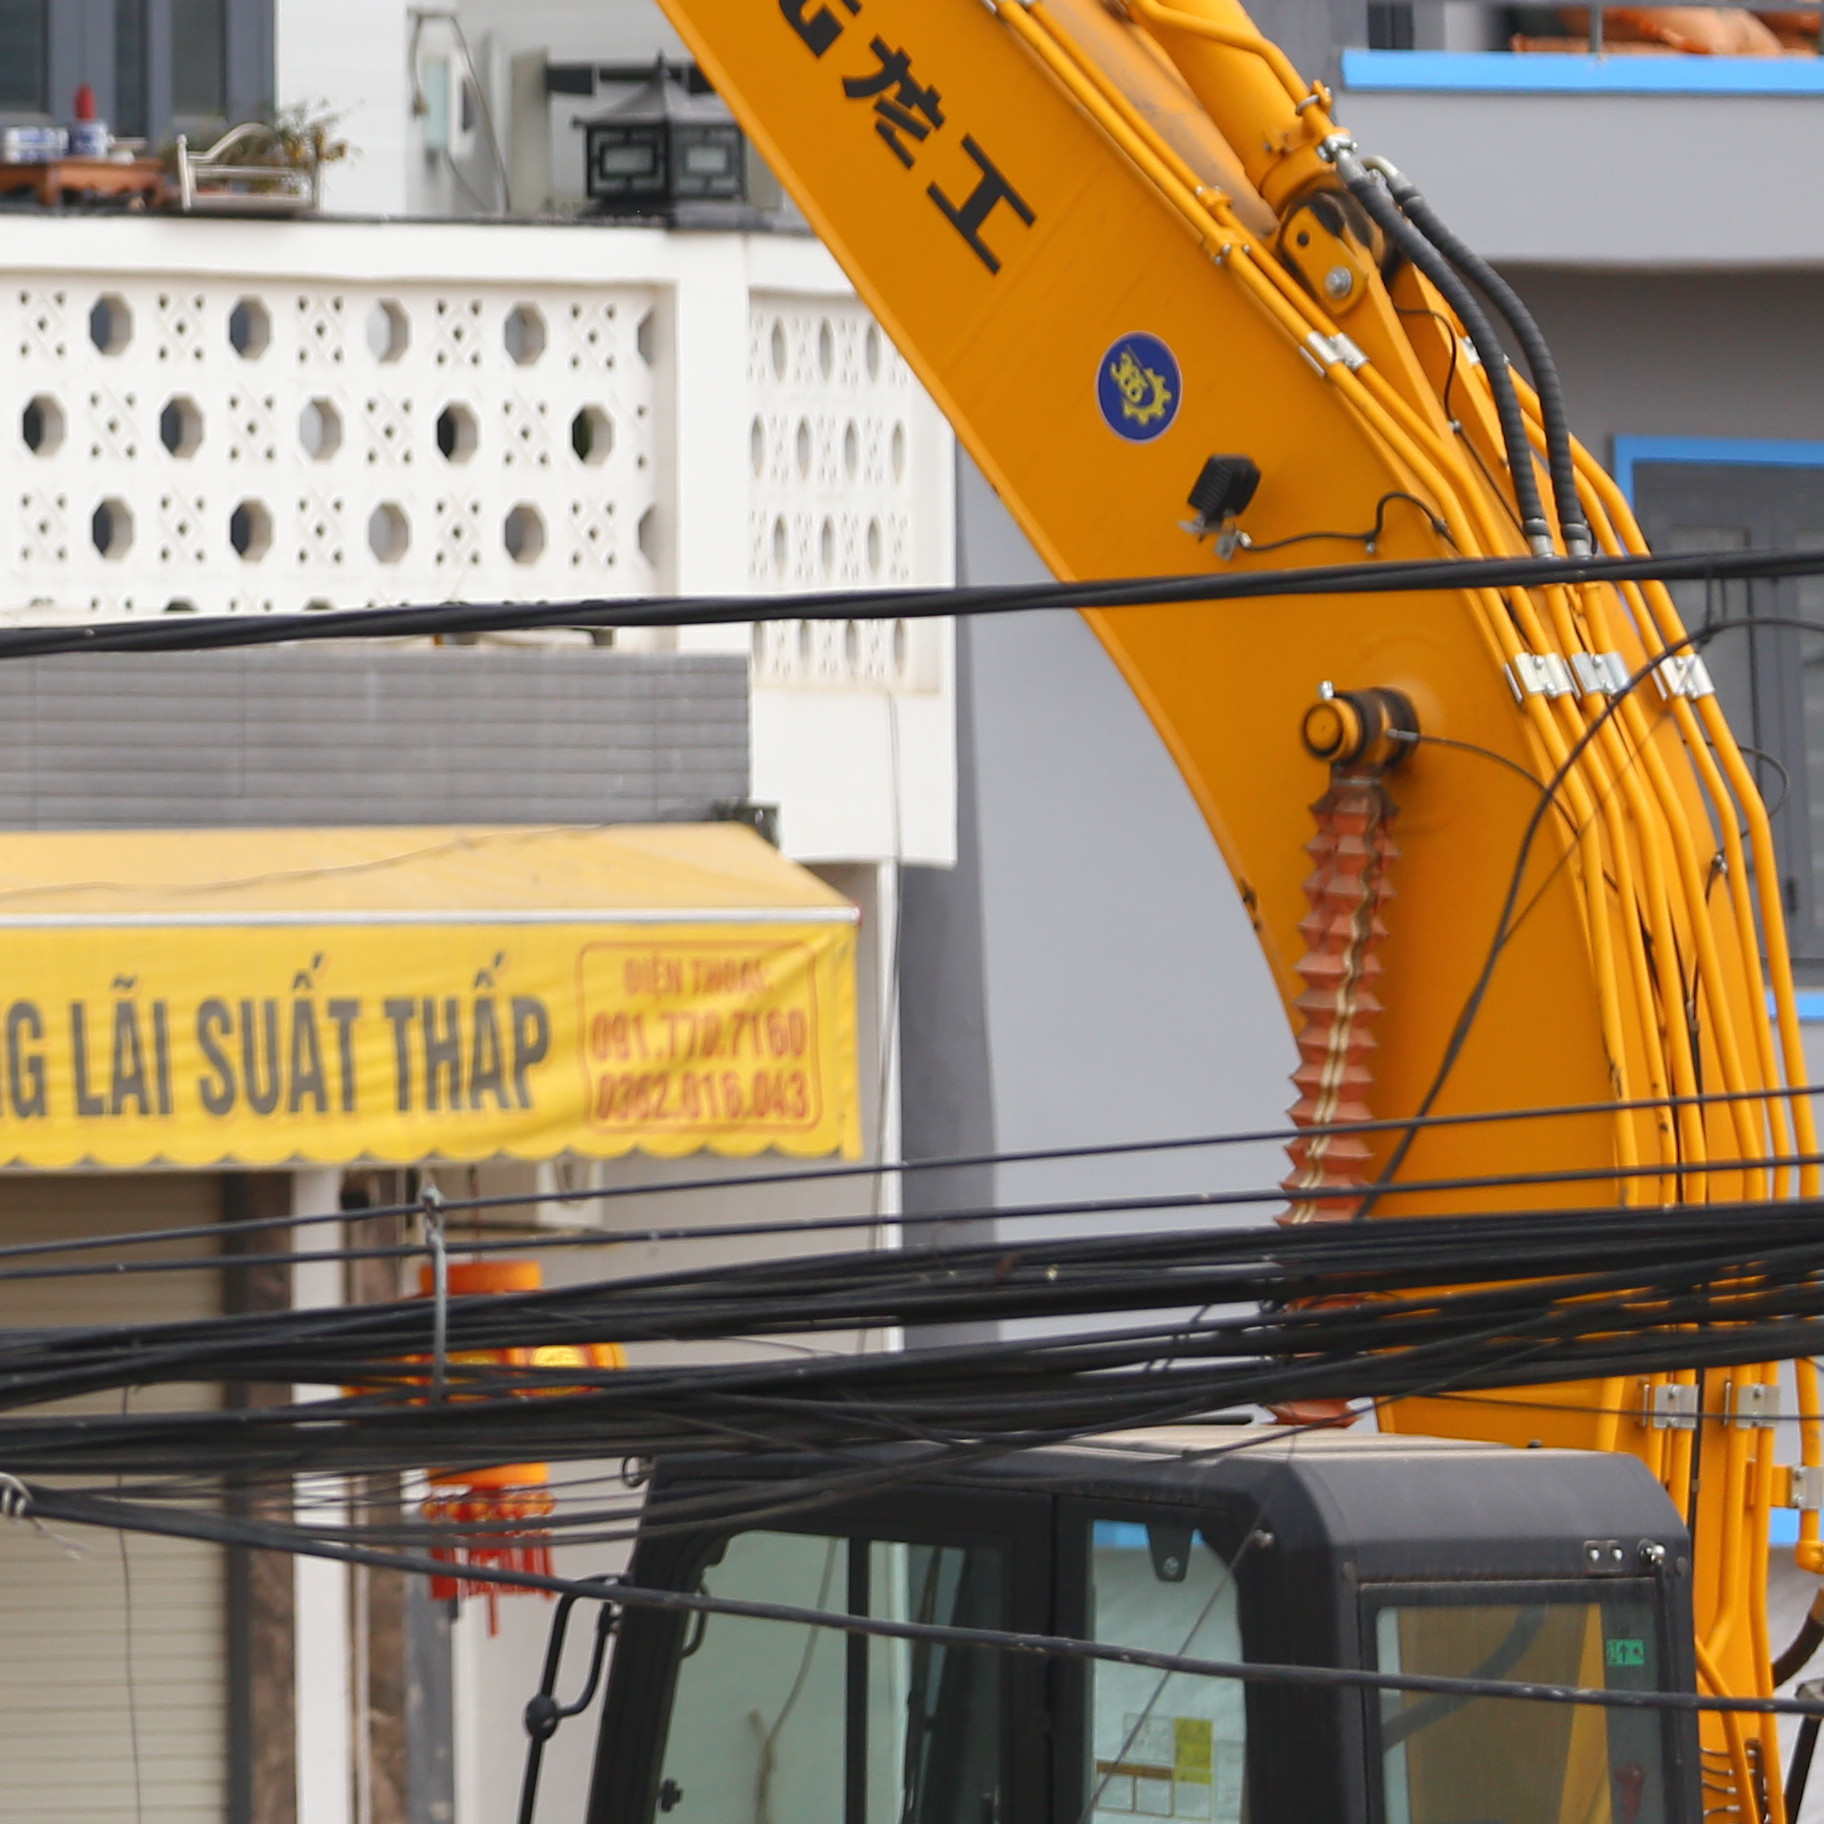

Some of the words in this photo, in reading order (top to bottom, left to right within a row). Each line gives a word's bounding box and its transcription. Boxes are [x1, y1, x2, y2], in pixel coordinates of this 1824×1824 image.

[70, 976, 172, 1117] LÃI
[196, 952, 359, 1117] SUẤT
[383, 951, 551, 1112] THẤP
